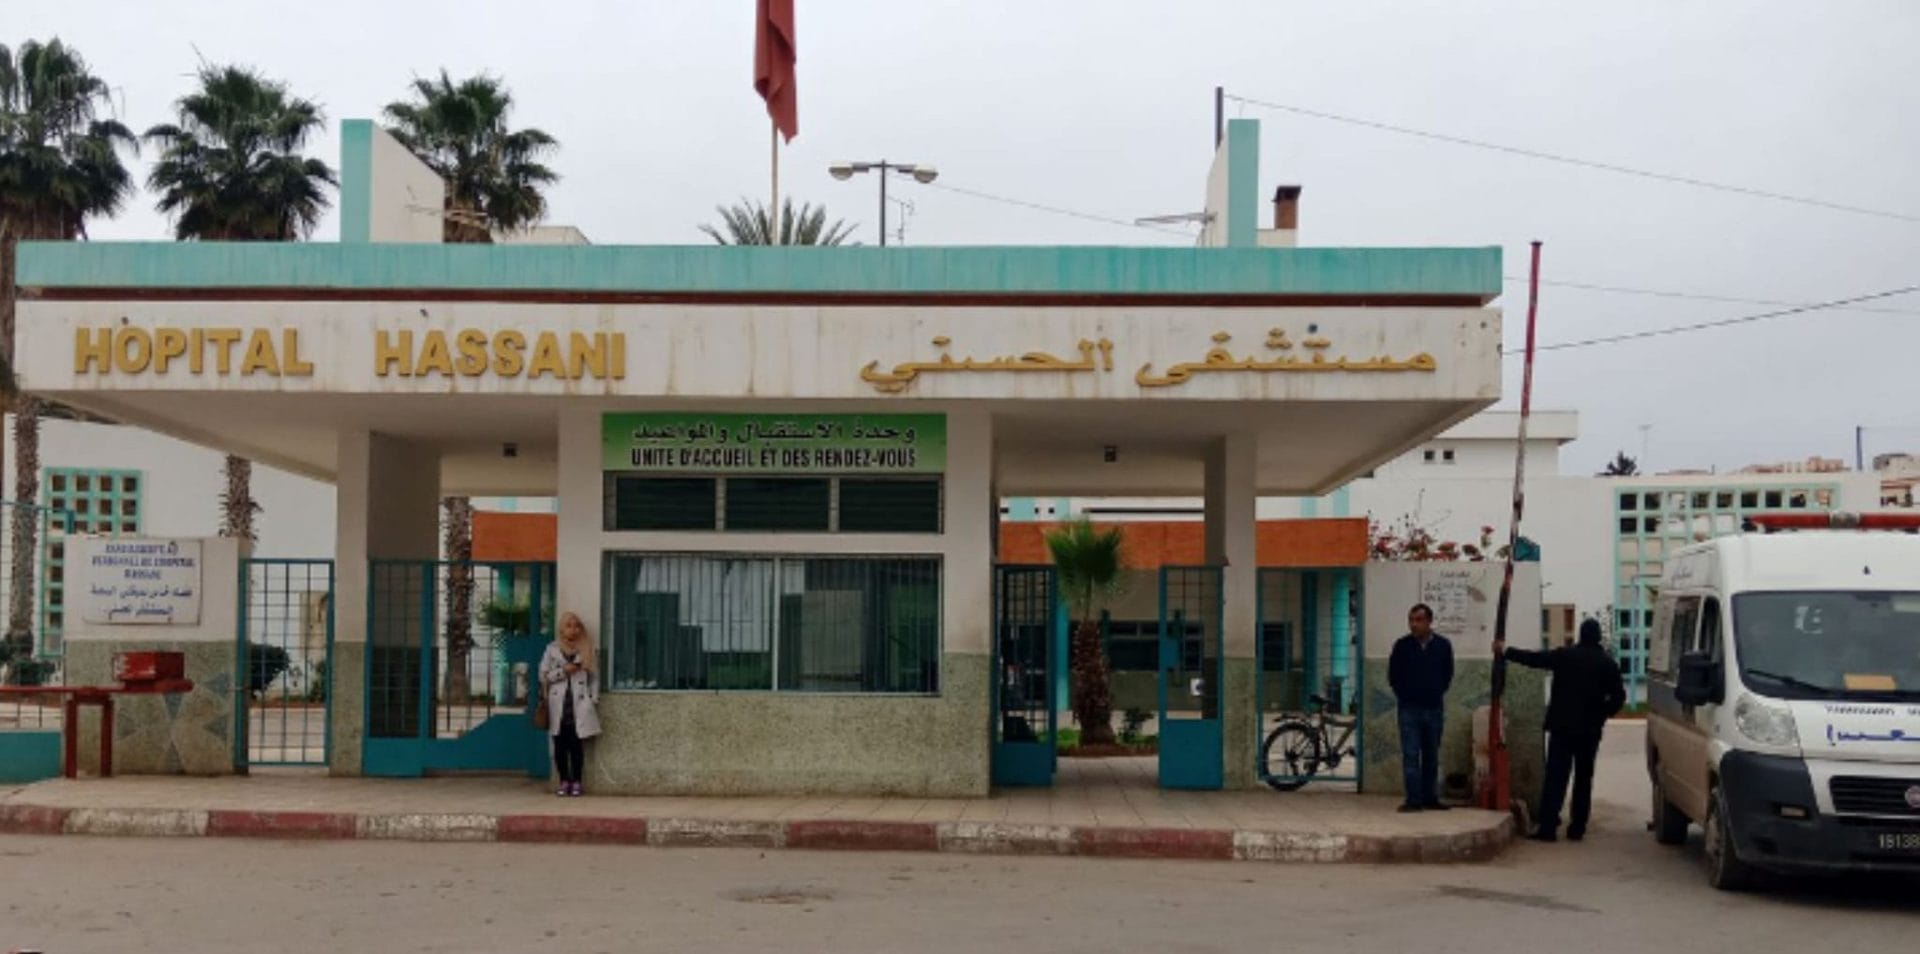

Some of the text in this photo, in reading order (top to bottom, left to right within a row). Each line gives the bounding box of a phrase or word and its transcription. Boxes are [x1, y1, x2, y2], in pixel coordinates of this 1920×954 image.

[74, 327, 626, 379] HOPITAL HASSANI
[860, 328, 1436, 394] مستشفى الحسني
[634, 416, 915, 446] وحدة الاستقبال والمواعيد
[631, 449, 916, 467] UNITE D'ACCUEIL ET DES RENDEZ-VOUS
